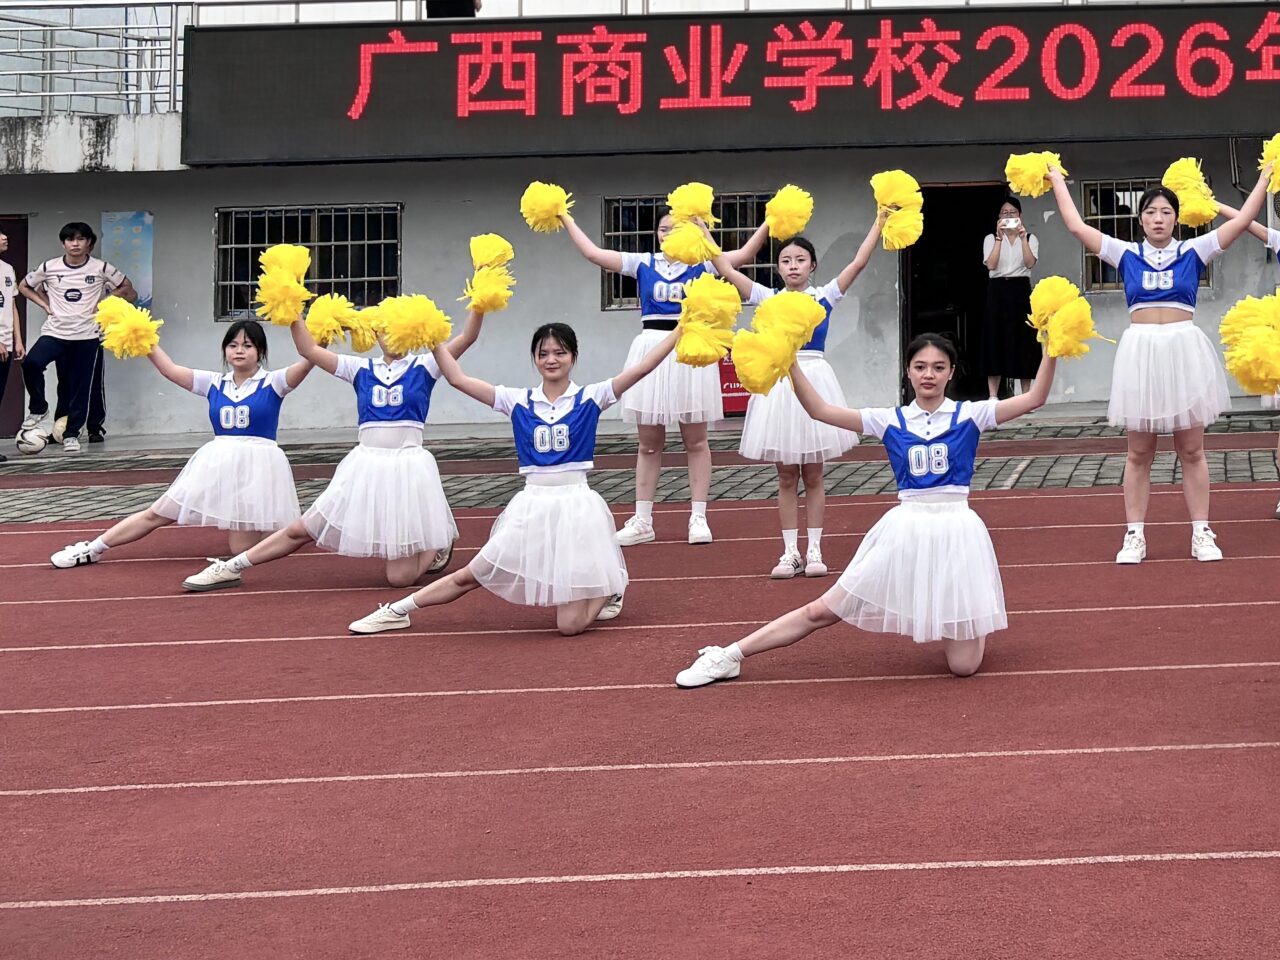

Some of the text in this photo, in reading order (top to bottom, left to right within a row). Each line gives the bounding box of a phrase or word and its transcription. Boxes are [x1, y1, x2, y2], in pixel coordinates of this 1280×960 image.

[653, 279, 683, 303] 08
[371, 384, 404, 407] 08
[219, 405, 250, 429] 08
[533, 424, 571, 453] 08
[908, 443, 949, 476] 08
